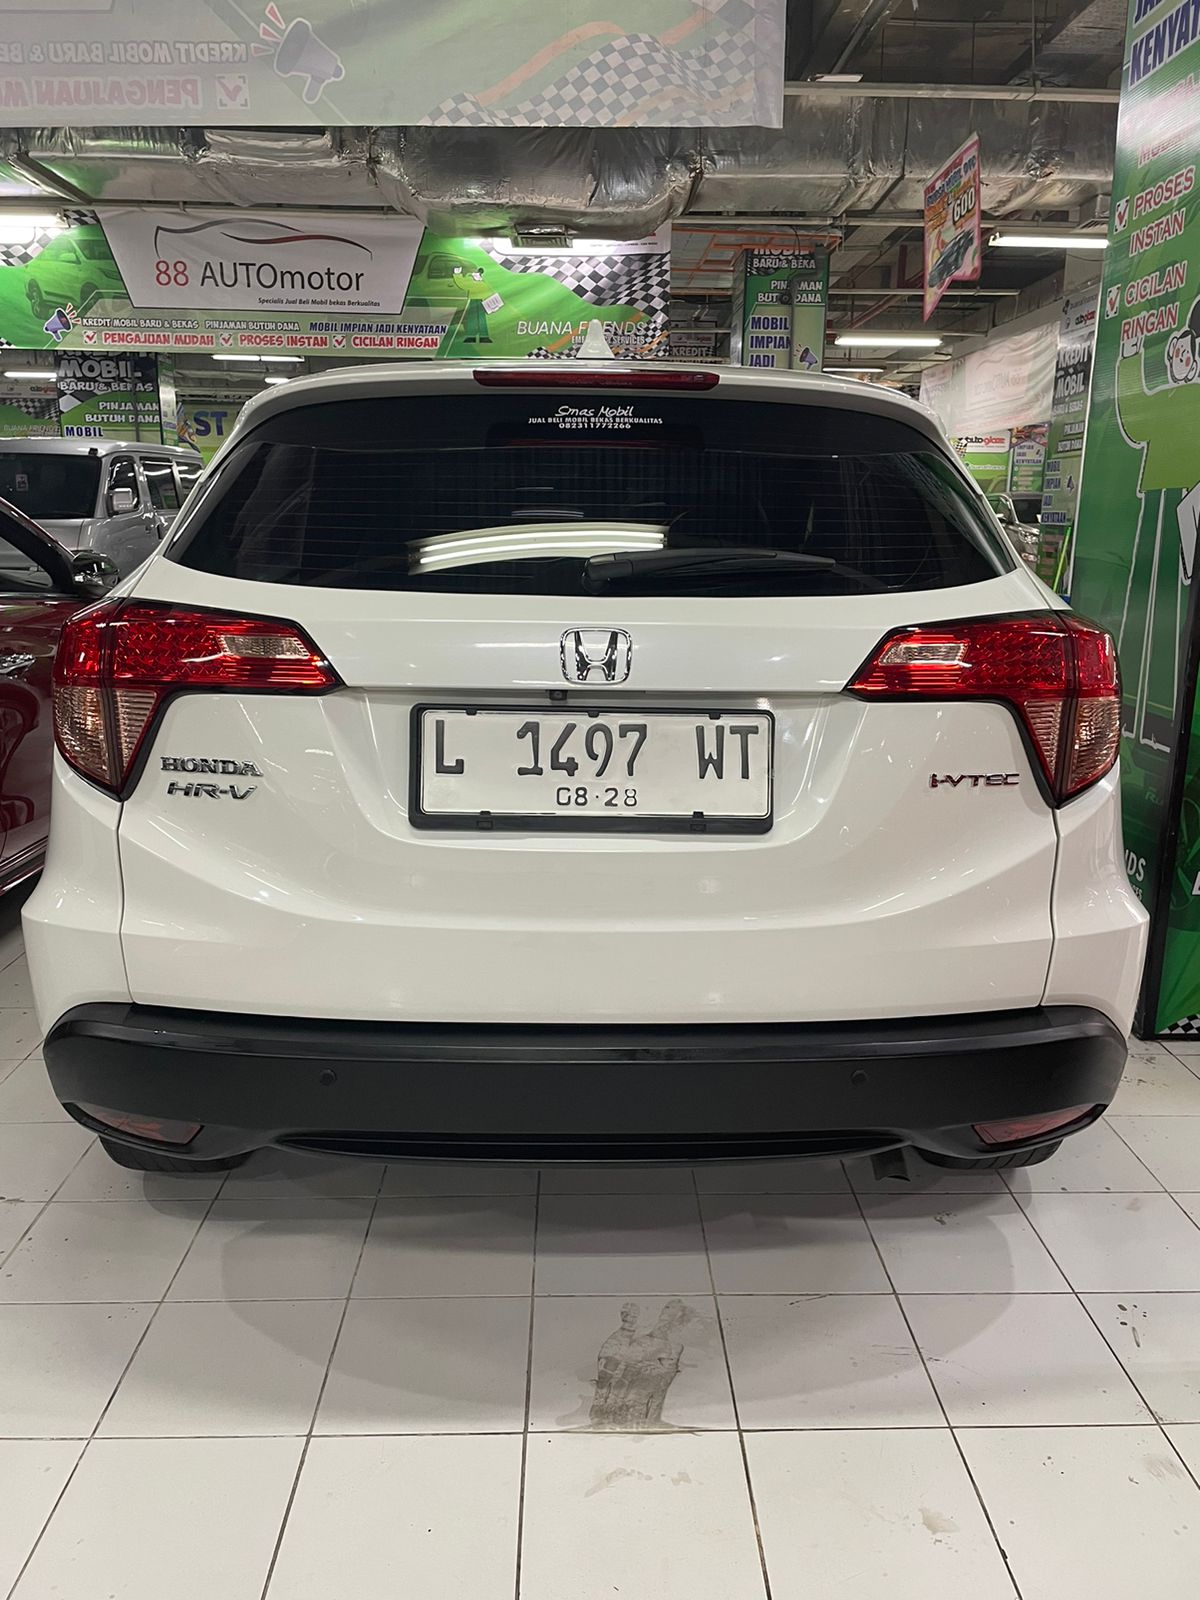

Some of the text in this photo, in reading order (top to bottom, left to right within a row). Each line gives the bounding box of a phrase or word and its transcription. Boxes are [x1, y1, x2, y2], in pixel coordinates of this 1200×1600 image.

[1130, 0, 1200, 86] KENYAT
[1134, 167, 1195, 219] PROSES
[1130, 209, 1185, 256] INSTAN
[753, 258, 779, 268] BARU
[791, 260, 816, 269] BEKA
[155, 260, 365, 291] 88 AUTOmotor
[1125, 262, 1187, 305] CICILAN
[311, 298, 328, 306] Mobil
[82, 319, 111, 328] KREDIT
[113, 320, 138, 328] MOBIL
[140, 320, 162, 328] BARU
[172, 320, 199, 329] BEKAS
[205, 320, 247, 330] PINJAMAN
[249, 321, 276, 331] BUTUH
[277, 322, 300, 331] DANA
[309, 322, 447, 334] MOBIL IMPIAN JADI KENYATAAN
[517, 321, 645, 335] BUANA FENDS
[751, 317, 790, 331] MOBIL
[1121, 303, 1179, 341] RINGAN
[103, 332, 439, 348] PENGAJUAN MUDAH PROSES INSTAN CICILAN RINGAN
[60, 381, 95, 390] BARU
[1055, 371, 1085, 399] MOBIL
[85, 414, 126, 423] BUTUH
[598, 405, 634, 418] Mobil
[65, 426, 104, 437] MOBIL
[435, 719, 760, 780] L 1497 WT
[160, 756, 264, 777] HONDA
[167, 781, 258, 800] HR-V
